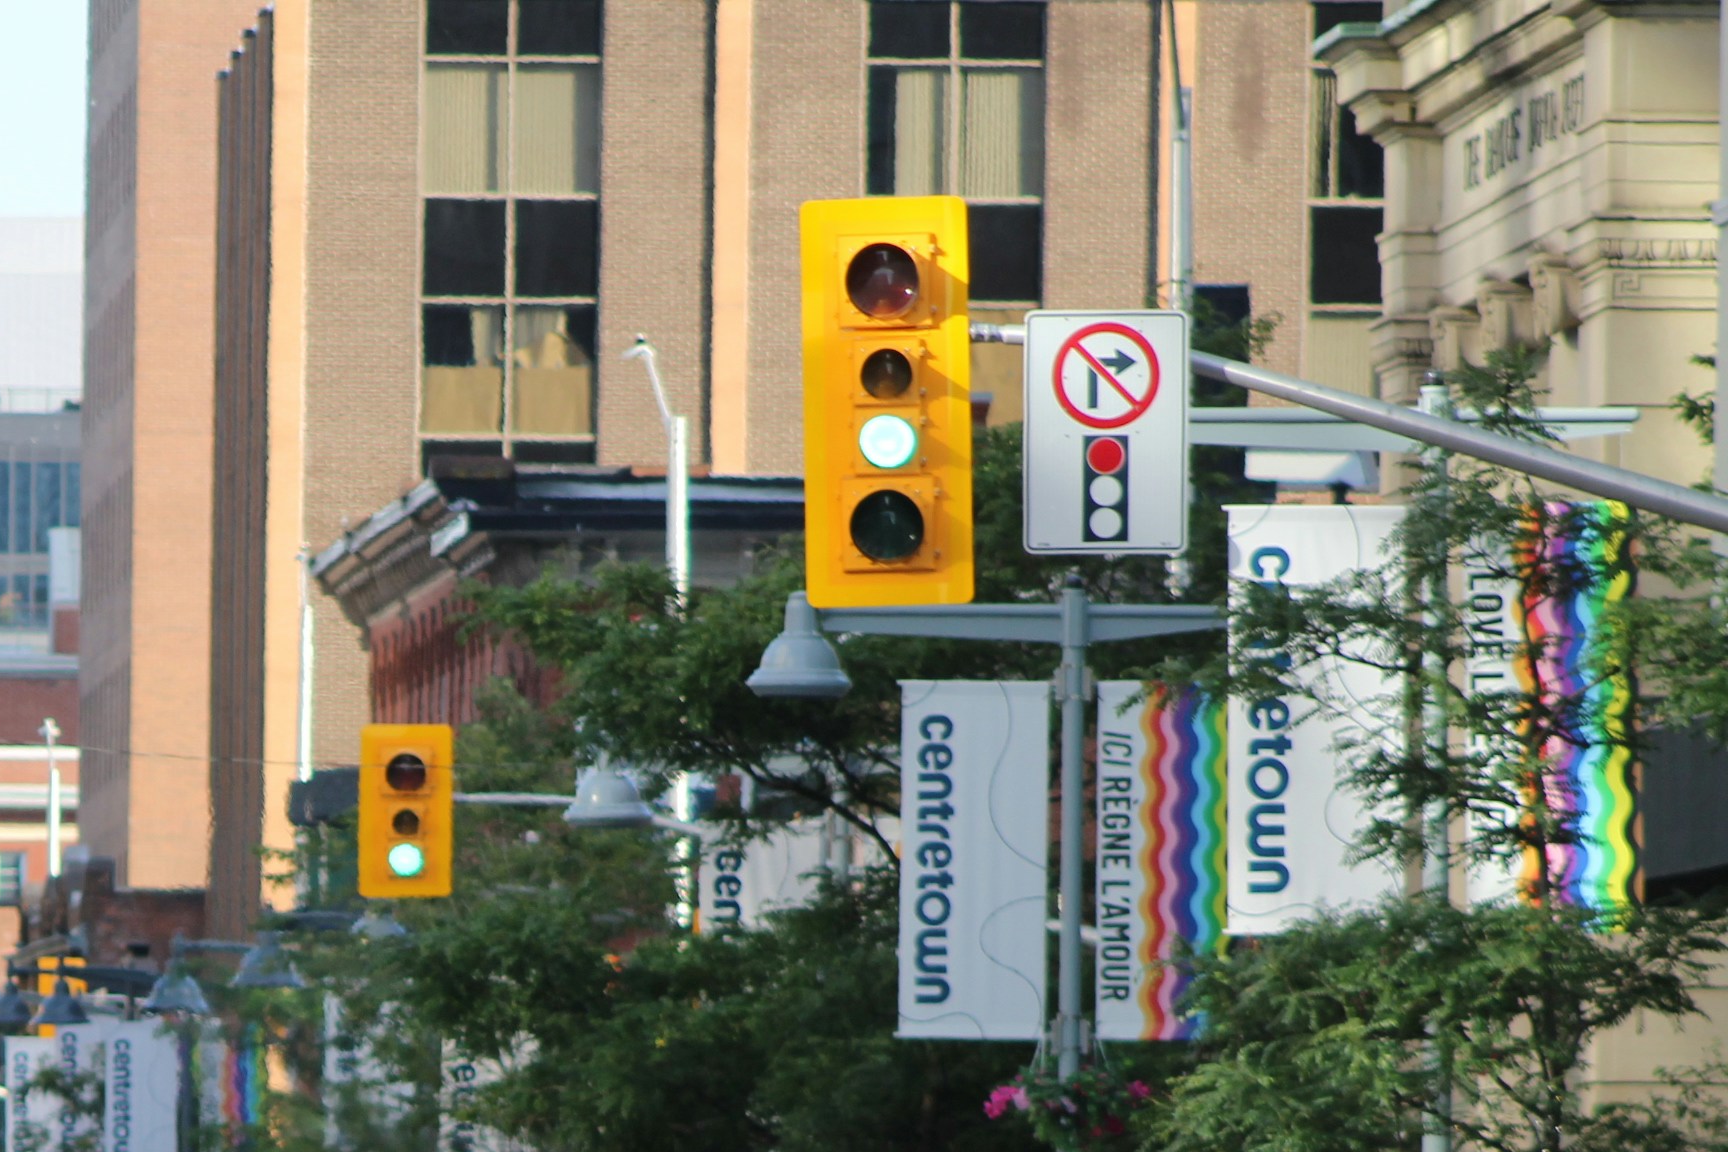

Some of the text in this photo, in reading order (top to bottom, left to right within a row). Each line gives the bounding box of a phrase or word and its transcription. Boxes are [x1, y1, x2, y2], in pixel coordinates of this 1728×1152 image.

[913, 713, 955, 1004] centretown
[1247, 545, 1292, 894] cetown
[1100, 730, 1140, 1002] ICI RÈGNE L'AMOUR
